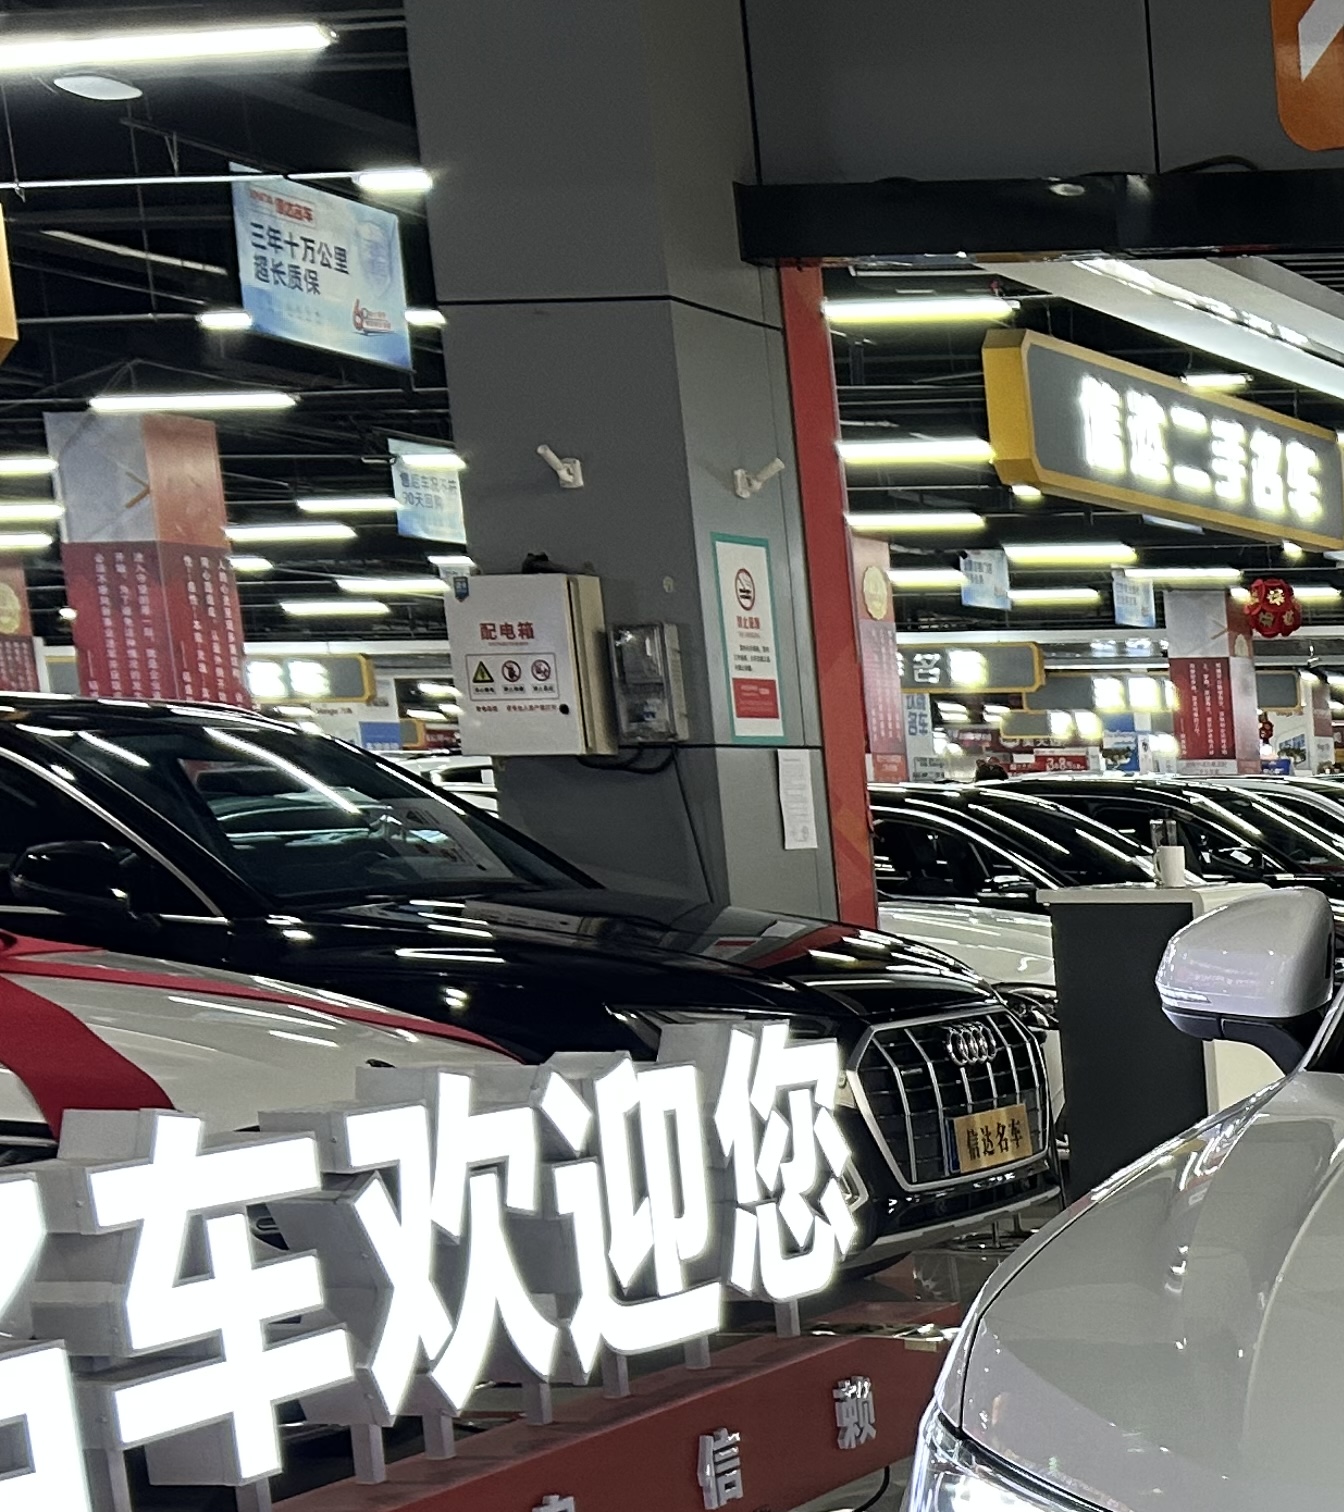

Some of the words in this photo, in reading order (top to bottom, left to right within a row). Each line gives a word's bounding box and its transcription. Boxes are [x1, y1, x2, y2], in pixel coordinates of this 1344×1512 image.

[250, 222, 350, 275] 三年十万公里
[254, 254, 321, 295] 超长质保
[479, 622, 535, 640] 配电箱
[966, 1118, 1023, 1160] 信达名车
